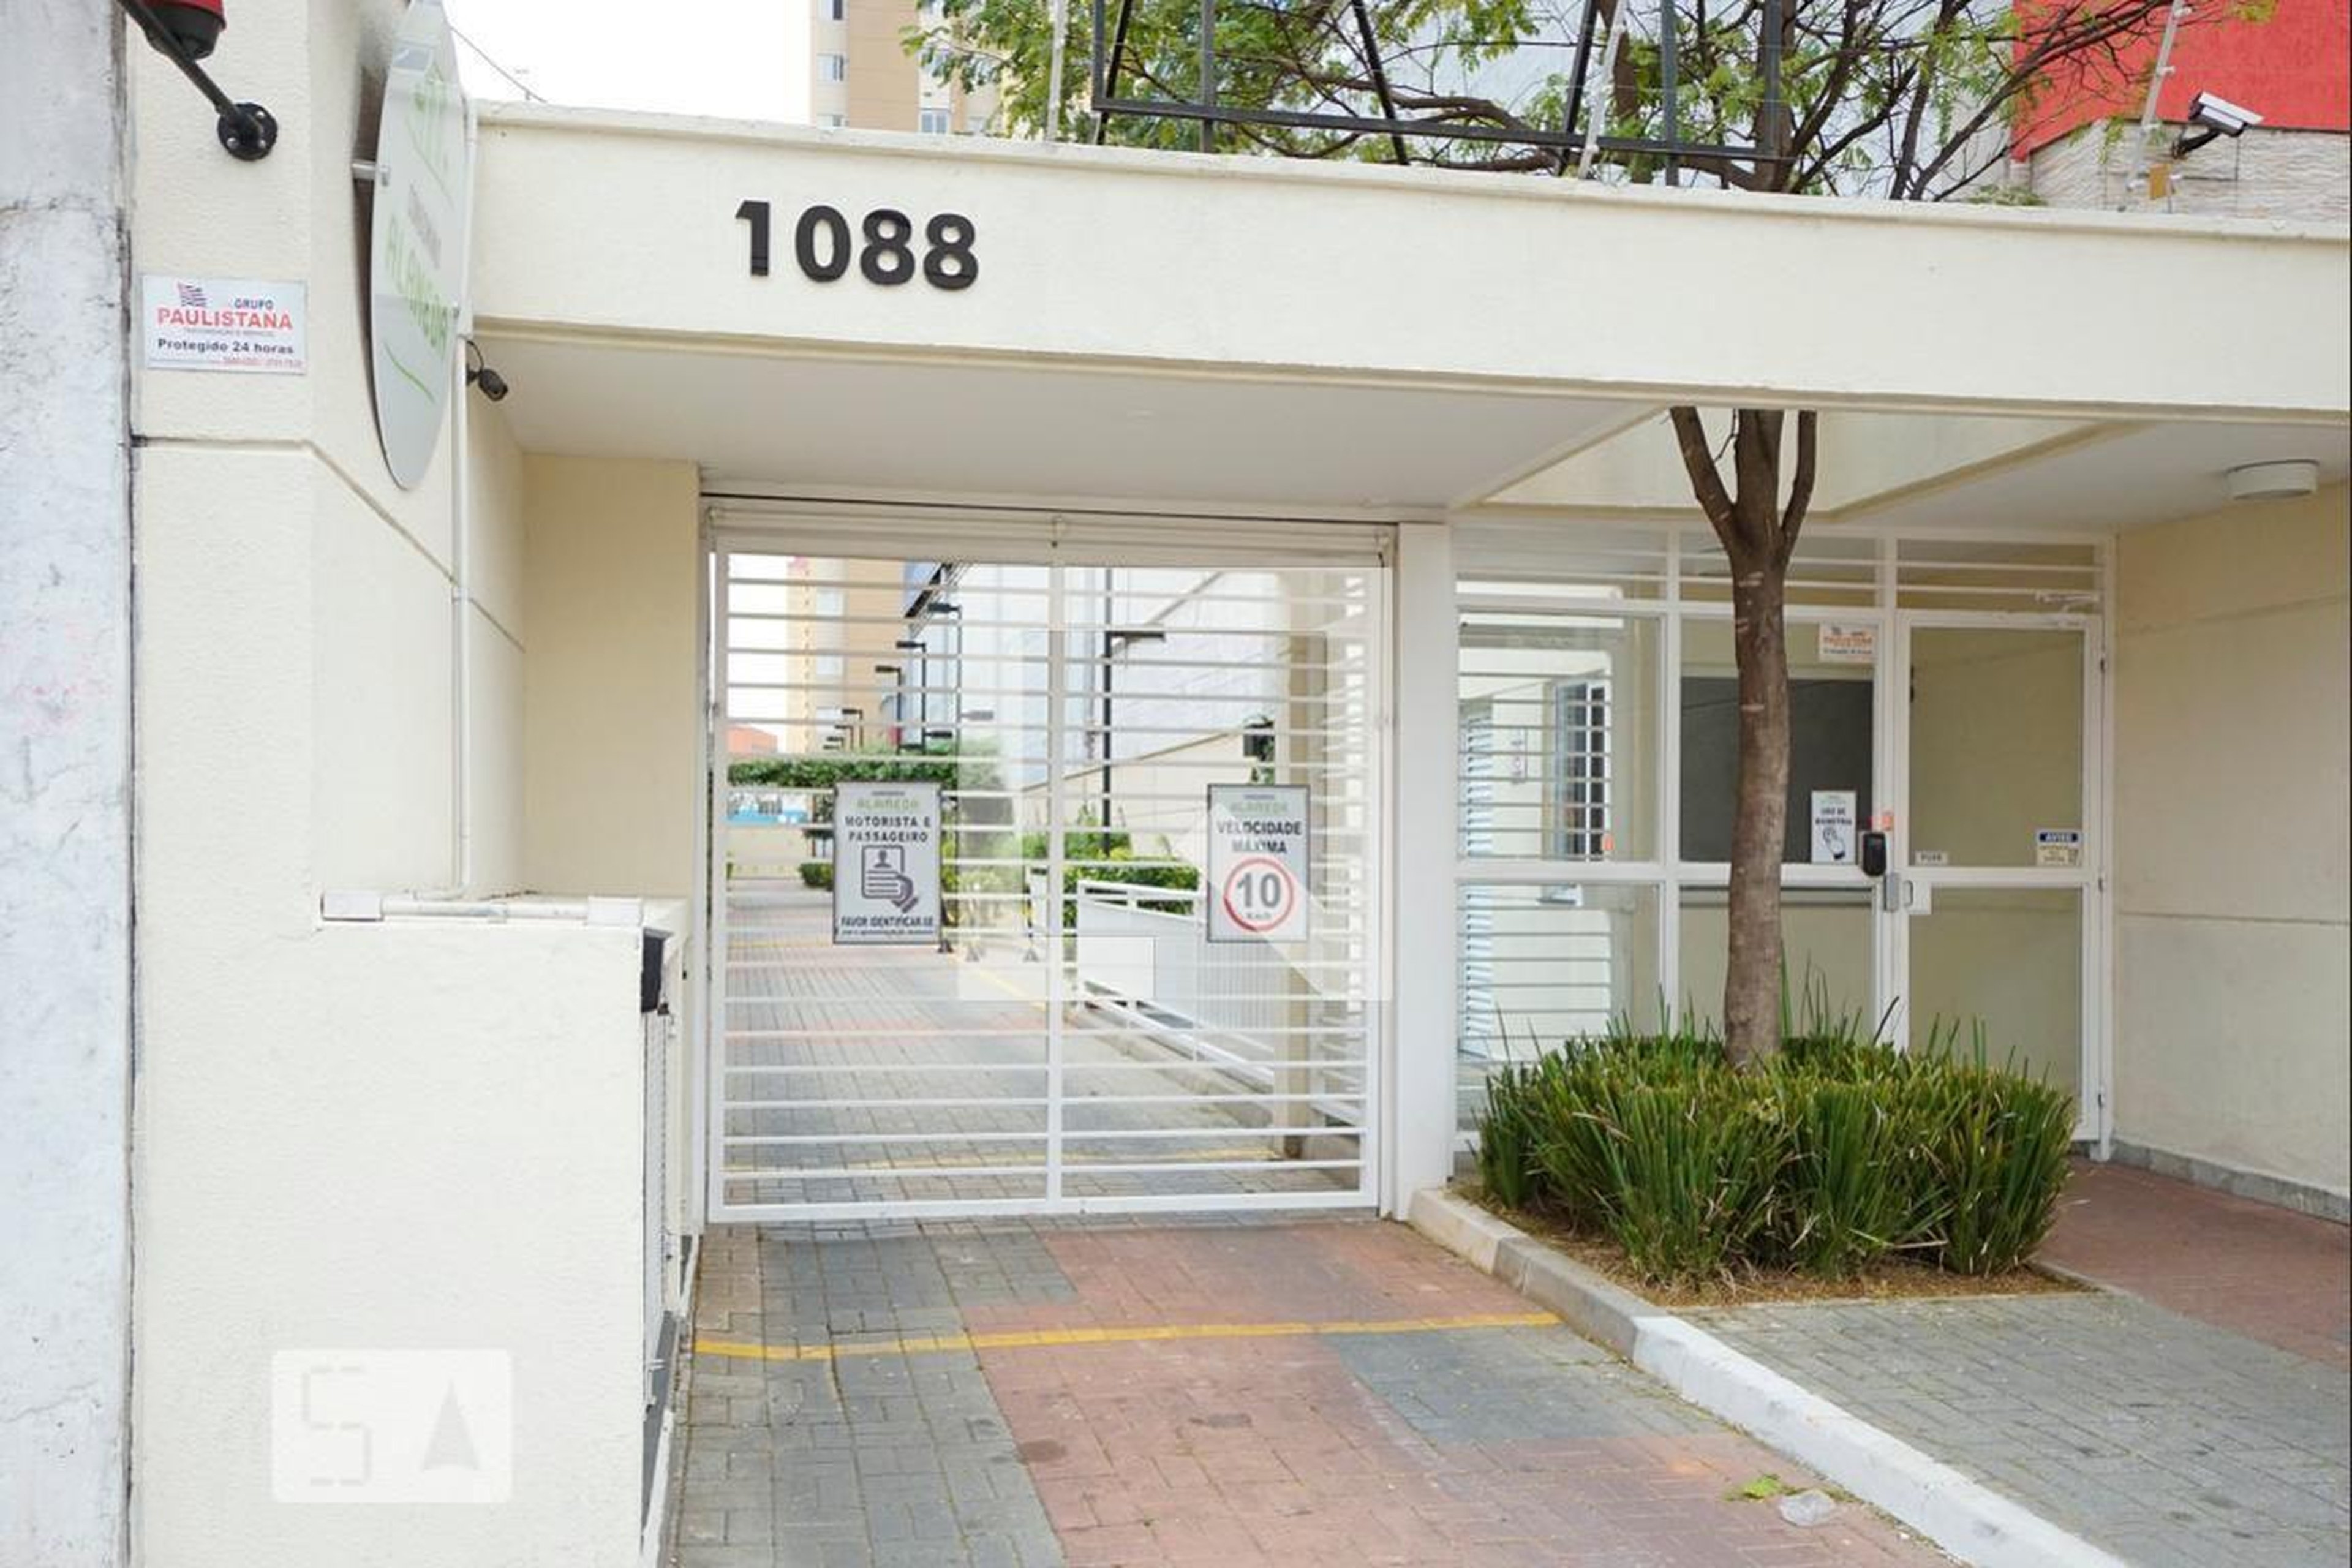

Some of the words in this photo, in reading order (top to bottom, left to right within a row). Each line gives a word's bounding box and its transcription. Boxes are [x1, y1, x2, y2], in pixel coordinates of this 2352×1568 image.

[735, 200, 978, 290] 1088
[234, 298, 274, 310] GRUPO
[157, 308, 293, 329] PAULISTANA
[158, 338, 228, 353] Protegido
[232, 341, 250, 352] 24
[254, 341, 294, 354] horas
[845, 816, 918, 827] MOTORISTA
[924, 816, 931, 827] E
[1217, 821, 1302, 835] VELOCIDADE
[848, 831, 929, 843] PASSAGEIRO
[1237, 872, 1281, 908] 10
